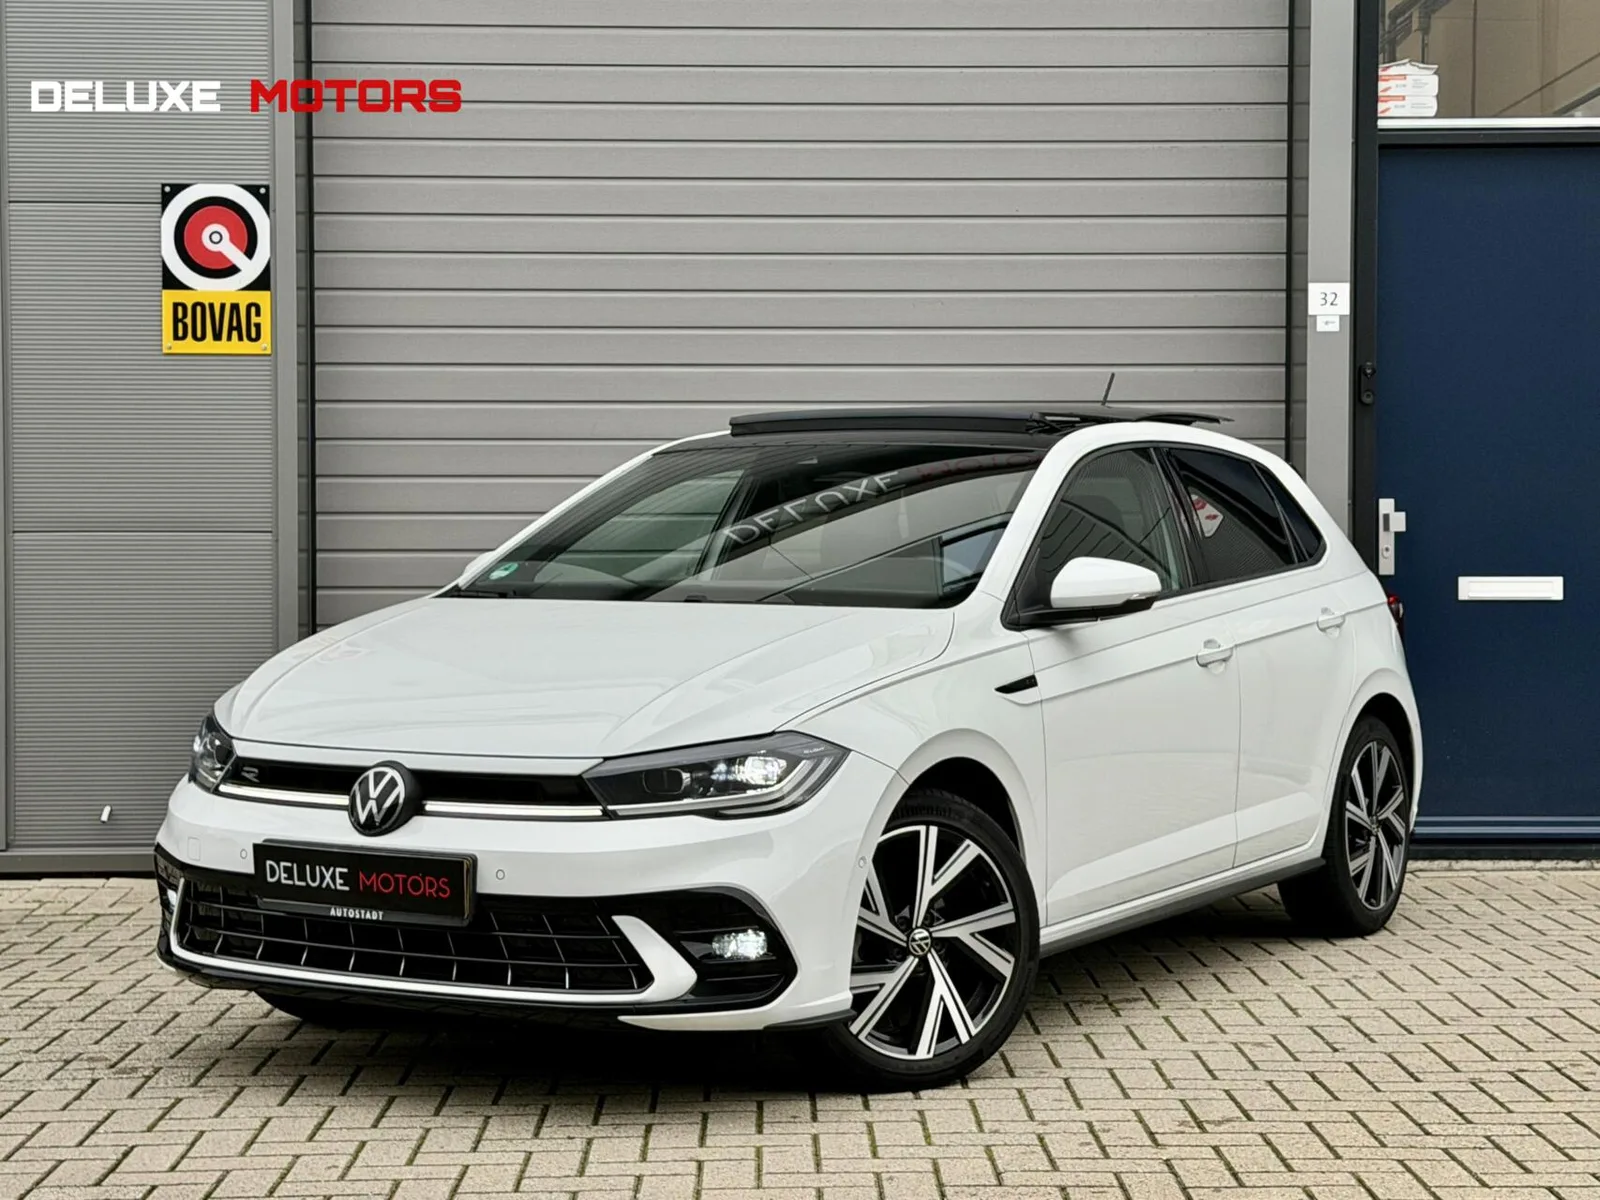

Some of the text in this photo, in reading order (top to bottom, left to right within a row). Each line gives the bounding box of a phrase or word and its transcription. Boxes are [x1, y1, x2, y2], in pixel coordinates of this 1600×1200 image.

[1319, 291, 1338, 306] 32
[172, 301, 262, 342] BOVAG
[265, 860, 450, 898] DELUXE MOTORS
[330, 906, 383, 921] AUTOSTADT
